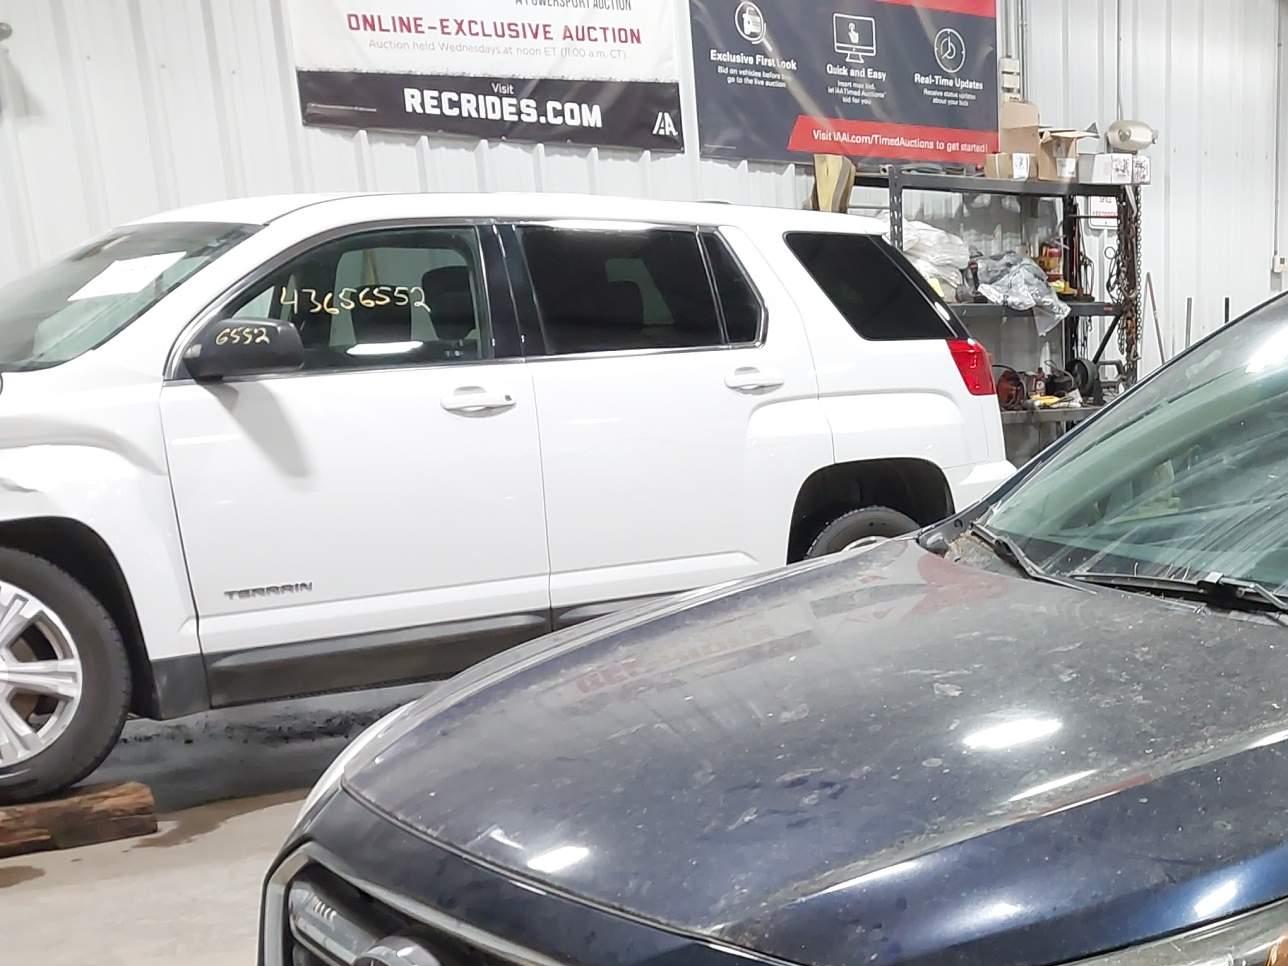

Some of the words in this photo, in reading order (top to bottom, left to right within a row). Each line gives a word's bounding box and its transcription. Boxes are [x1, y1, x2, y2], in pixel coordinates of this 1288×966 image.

[593, 0, 632, 11] AUCTION
[346, 13, 554, 41] ONLINE-EXCLUSIVE
[562, 24, 642, 44] AUCTION
[369, 39, 410, 51] Auction
[412, 41, 436, 52] held
[437, 42, 502, 56] Wednesdays
[503, 46, 513, 56] at
[516, 47, 542, 57] noon
[544, 47, 556, 57] ET
[710, 48, 754, 65] Exclusive
[755, 54, 776, 67] First
[717, 65, 729, 74] Bid
[826, 63, 849, 76] Quick
[849, 67, 866, 78] and
[867, 68, 887, 82] Easy
[491, 82, 514, 95] Visit
[914, 73, 954, 88] Real-Time
[954, 77, 984, 90] Updates
[403, 87, 603, 128] RECRIDES.COM
[812, 129, 832, 142] Visit
[936, 143, 945, 151] to
[946, 142, 960, 153] get
[961, 143, 988, 153] started!
[279, 286, 432, 315] 43656552
[215, 326, 271, 346] 6552
[223, 581, 313, 601] TERRAIN
